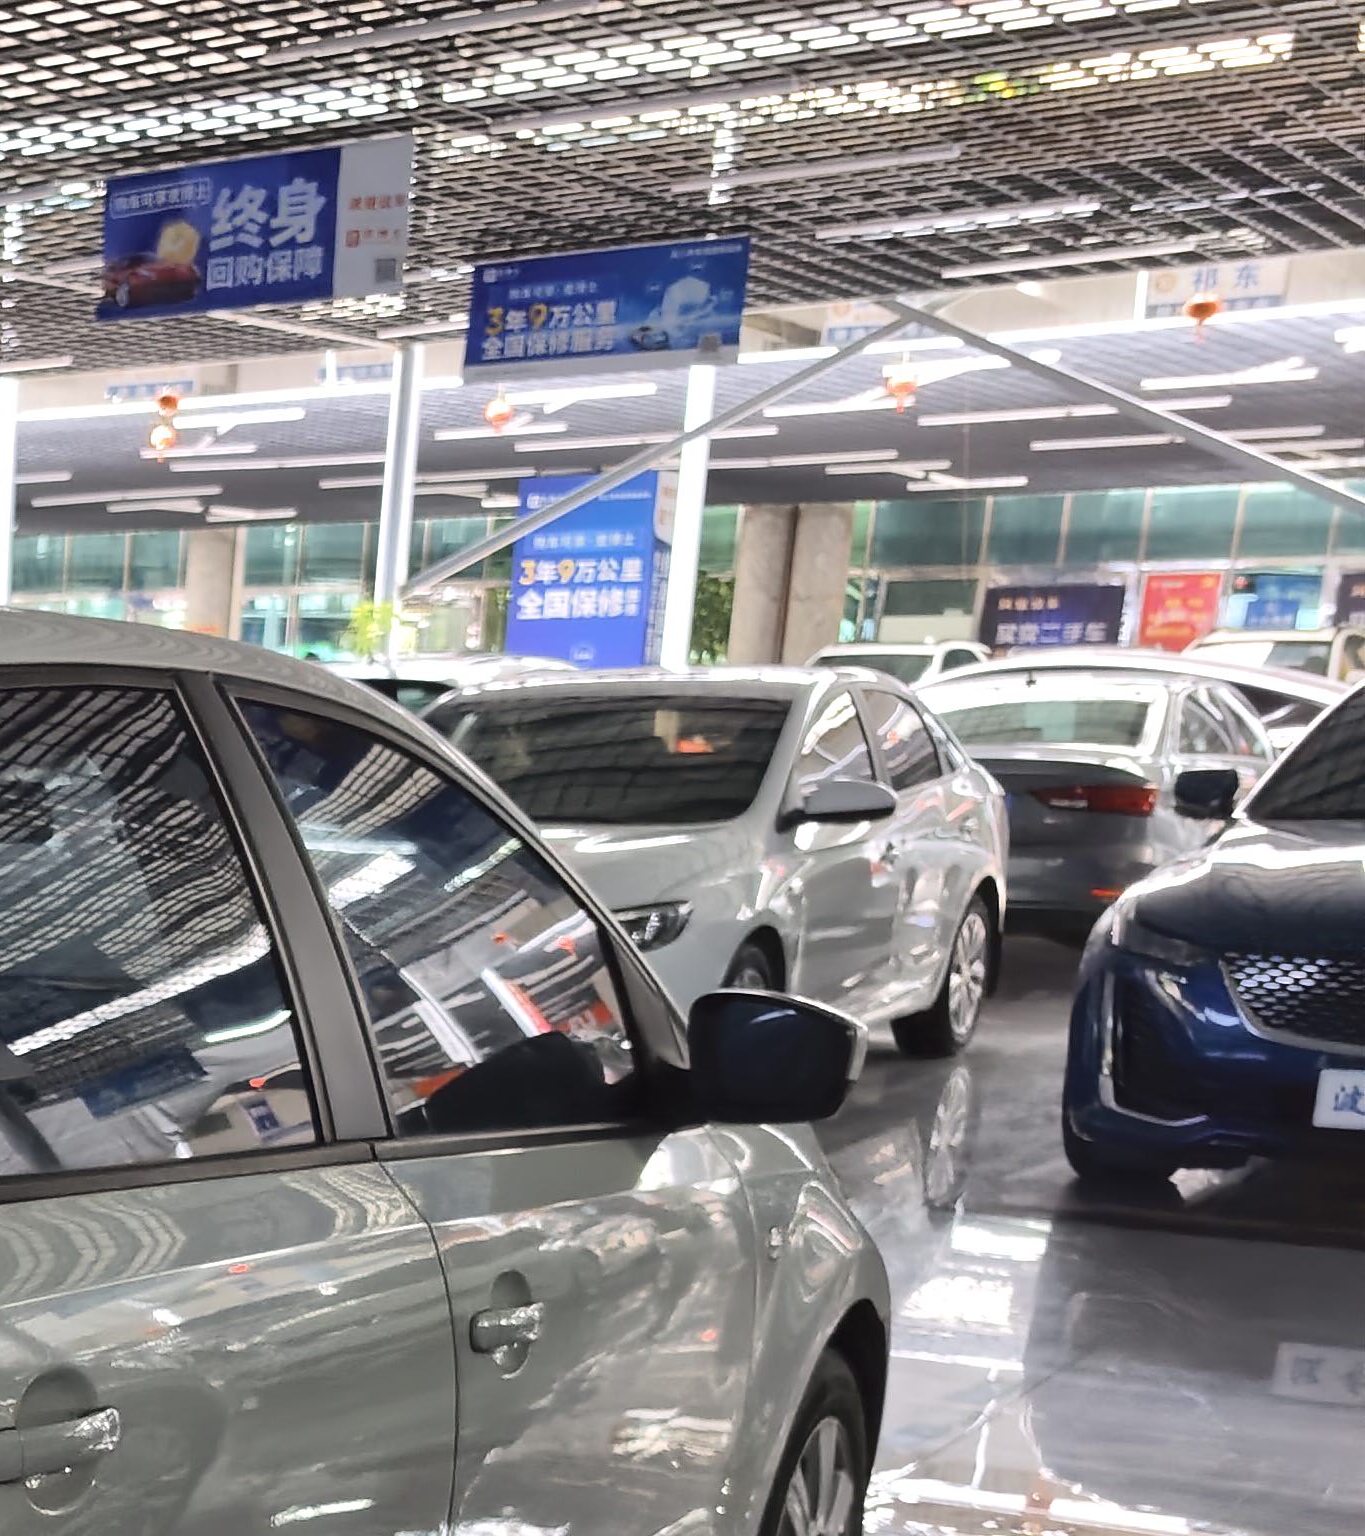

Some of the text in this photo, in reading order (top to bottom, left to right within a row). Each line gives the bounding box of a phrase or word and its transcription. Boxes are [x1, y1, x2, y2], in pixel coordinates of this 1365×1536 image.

[208, 177, 327, 252] 终身
[205, 246, 324, 292] 回购保障
[519, 557, 644, 586] 3年9万公里
